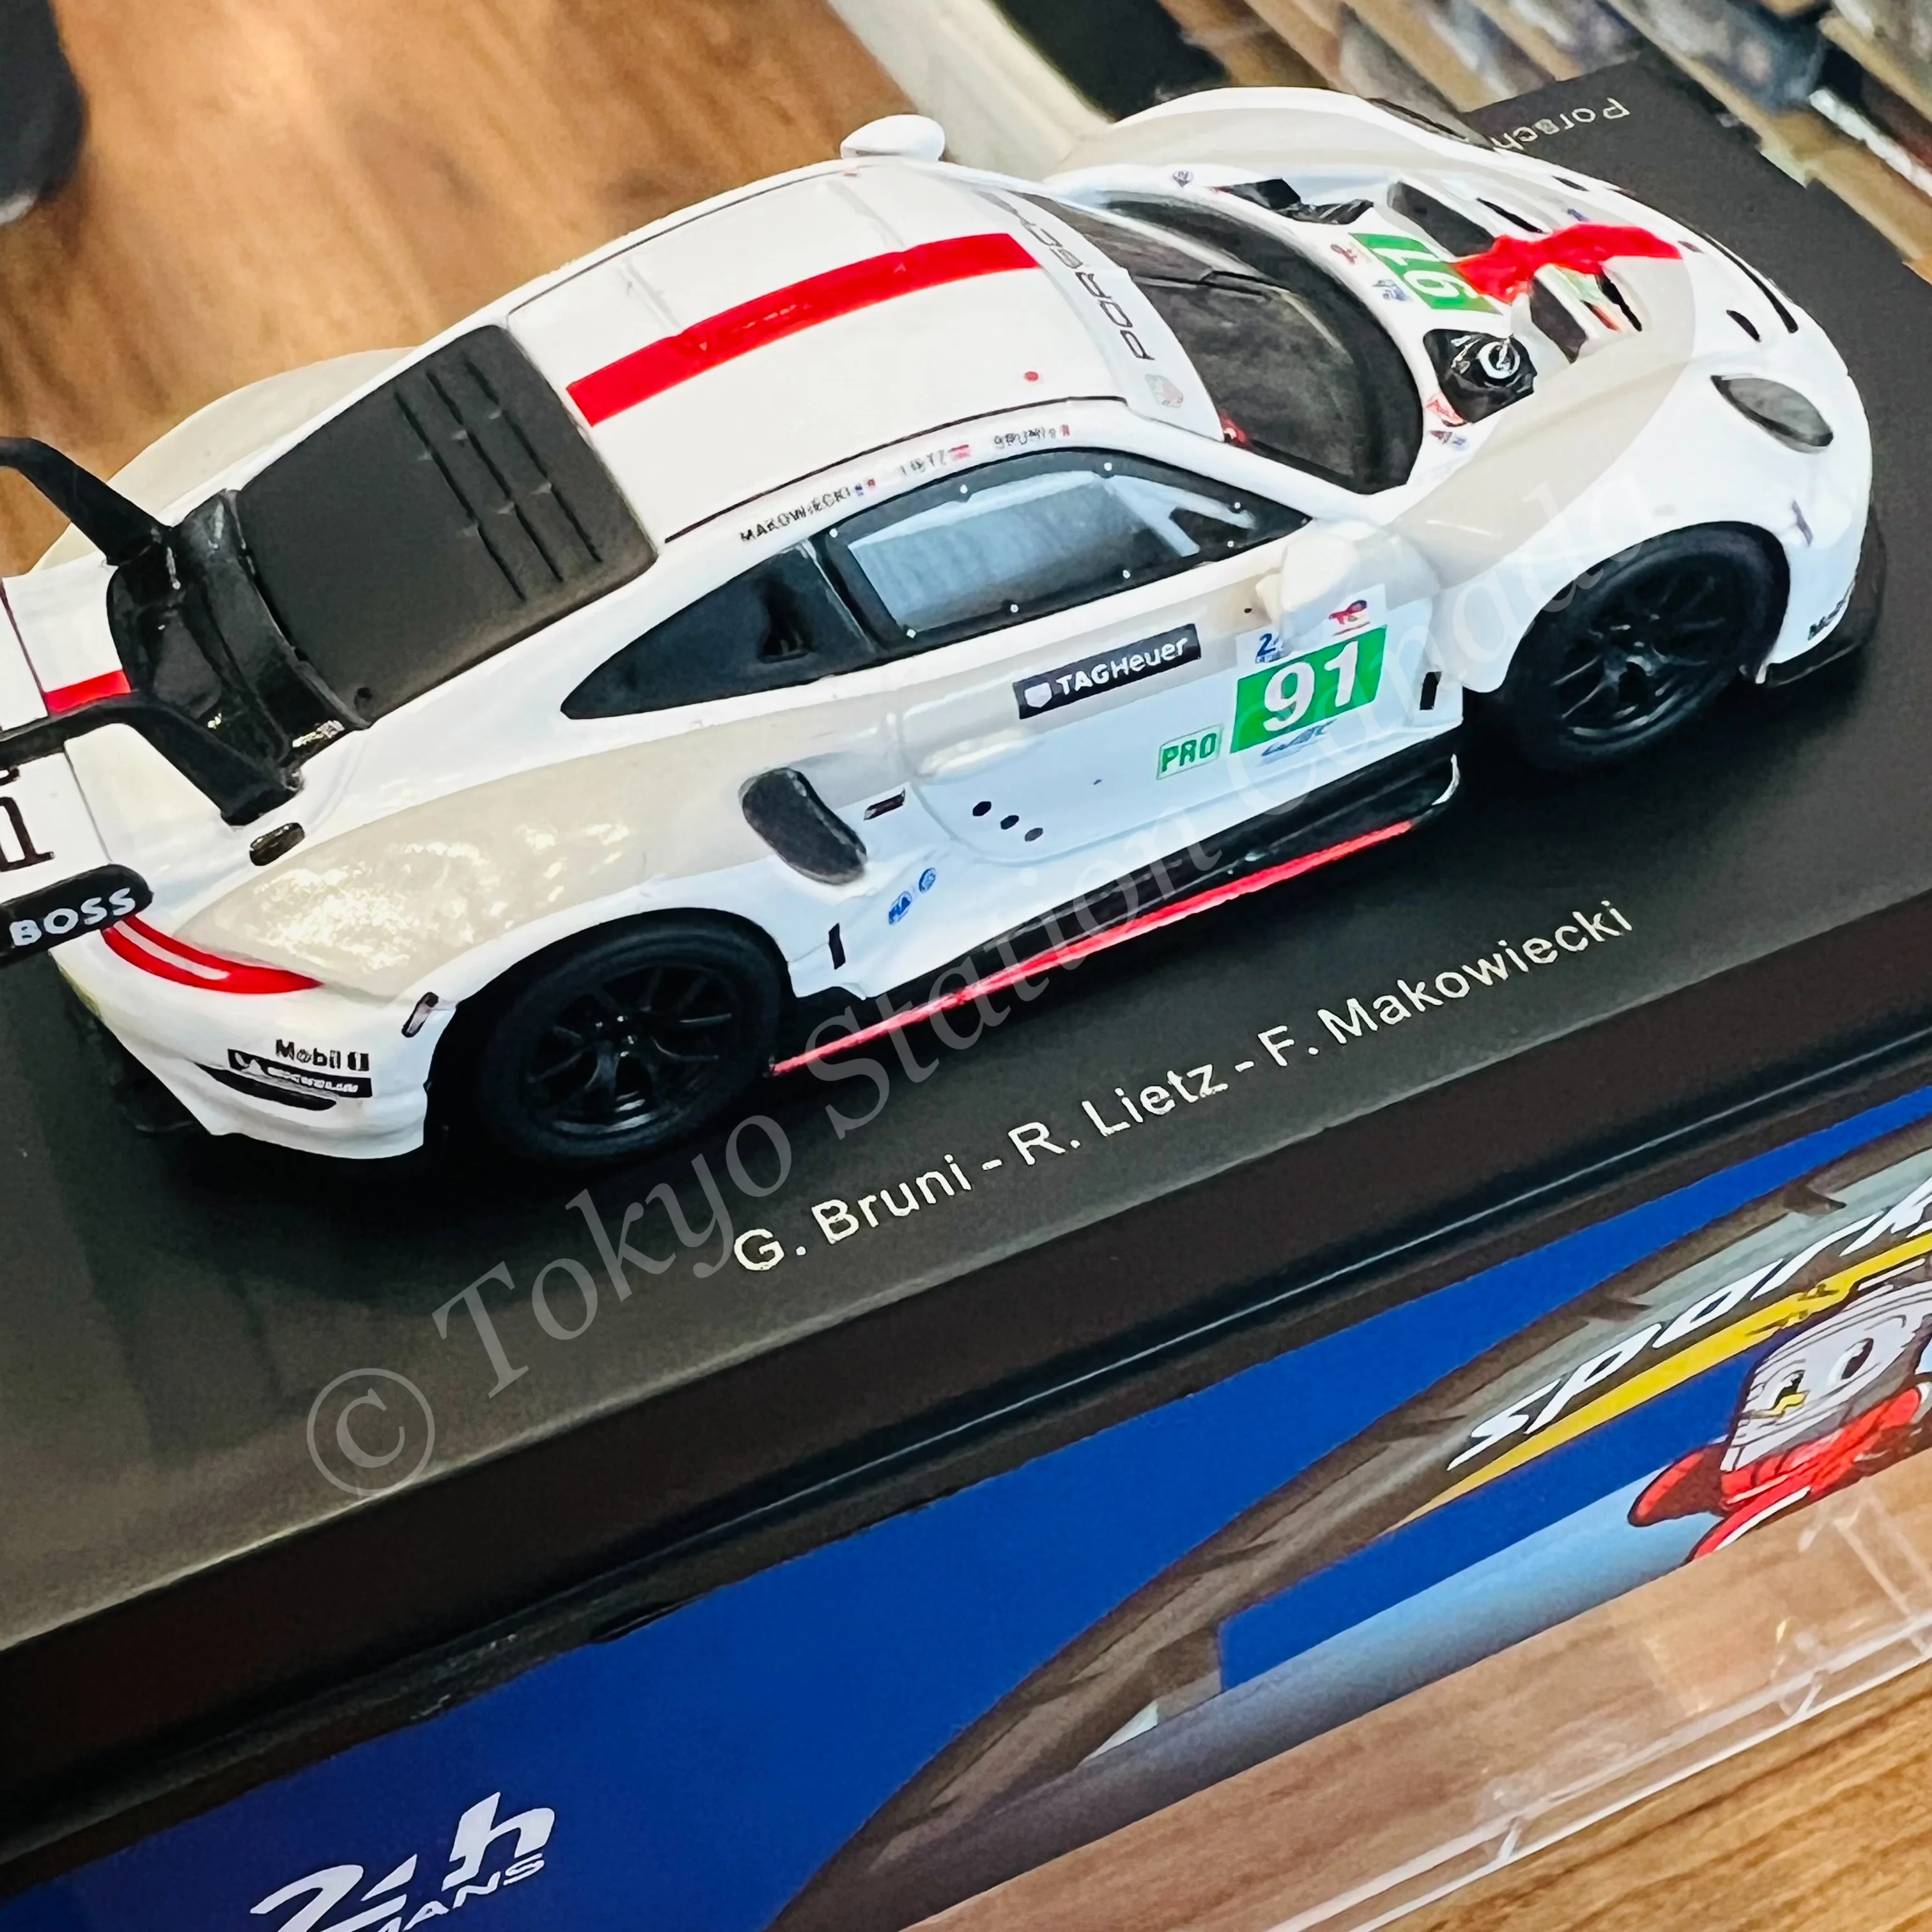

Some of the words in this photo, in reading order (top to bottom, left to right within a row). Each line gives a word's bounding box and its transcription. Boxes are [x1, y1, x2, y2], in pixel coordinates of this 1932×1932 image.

[1489, 97, 1630, 151] Porsch
[1263, 641, 1359, 732] 91
[1161, 732, 1218, 773] PRO
[8, 887, 135, 946] BOSS
[275, 1039, 341, 1070] Mobil
[733, 1228, 806, 1271] G.
[811, 1153, 973, 1245] Bruni
[1008, 1121, 1081, 1165] R.
[1081, 1063, 1229, 1137] Lietz
[1257, 1025, 1320, 1067] F.
[1317, 900, 1633, 1045] Makowiecki
